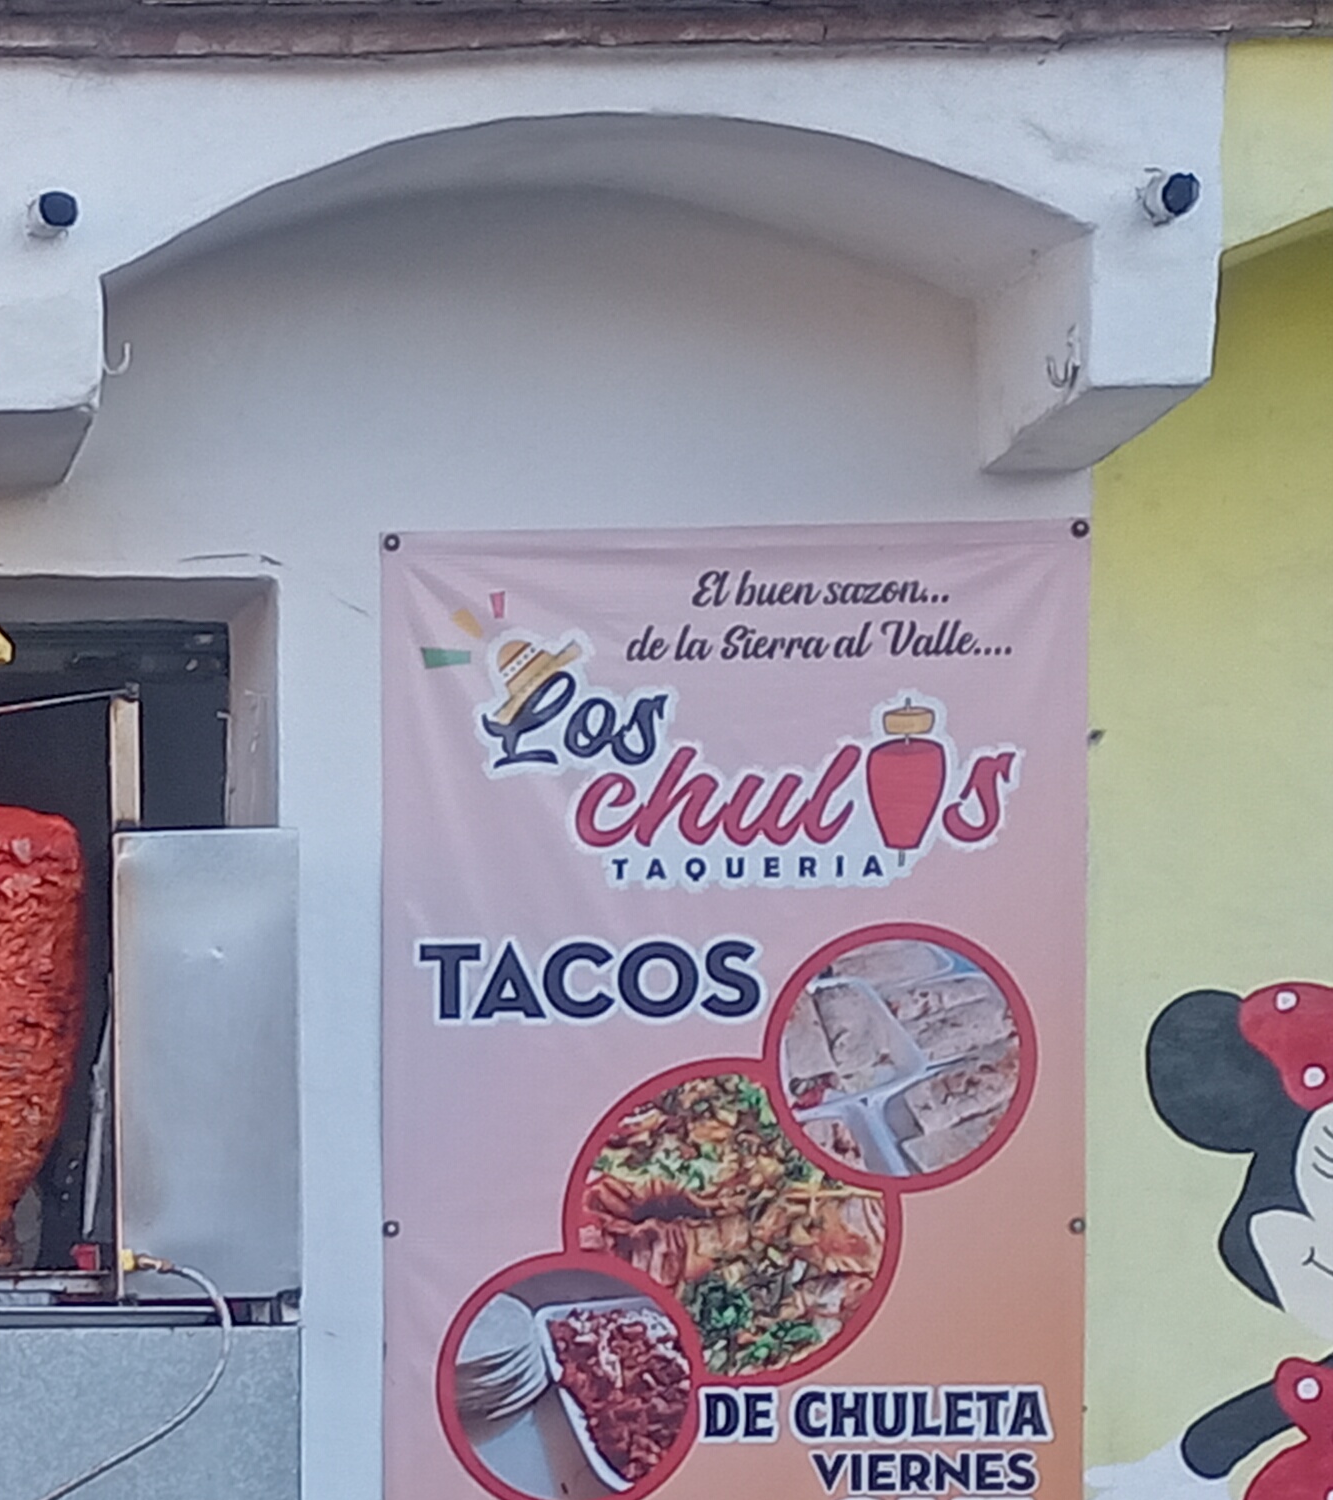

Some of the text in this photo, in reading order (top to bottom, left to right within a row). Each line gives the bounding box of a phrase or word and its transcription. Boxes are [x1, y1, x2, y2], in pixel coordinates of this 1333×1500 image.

[692, 570, 727, 607] El
[735, 570, 820, 606] buen
[626, 625, 670, 662] de
[675, 625, 712, 662] la
[721, 626, 829, 661] Sierra
[833, 624, 871, 659] al
[481, 671, 668, 770] Los
[611, 855, 885, 881] TAQUERIA
[419, 940, 761, 1020] TACOS
[703, 1390, 1049, 1438] DE CHULETA
[812, 1452, 1035, 1492] VIERNES
